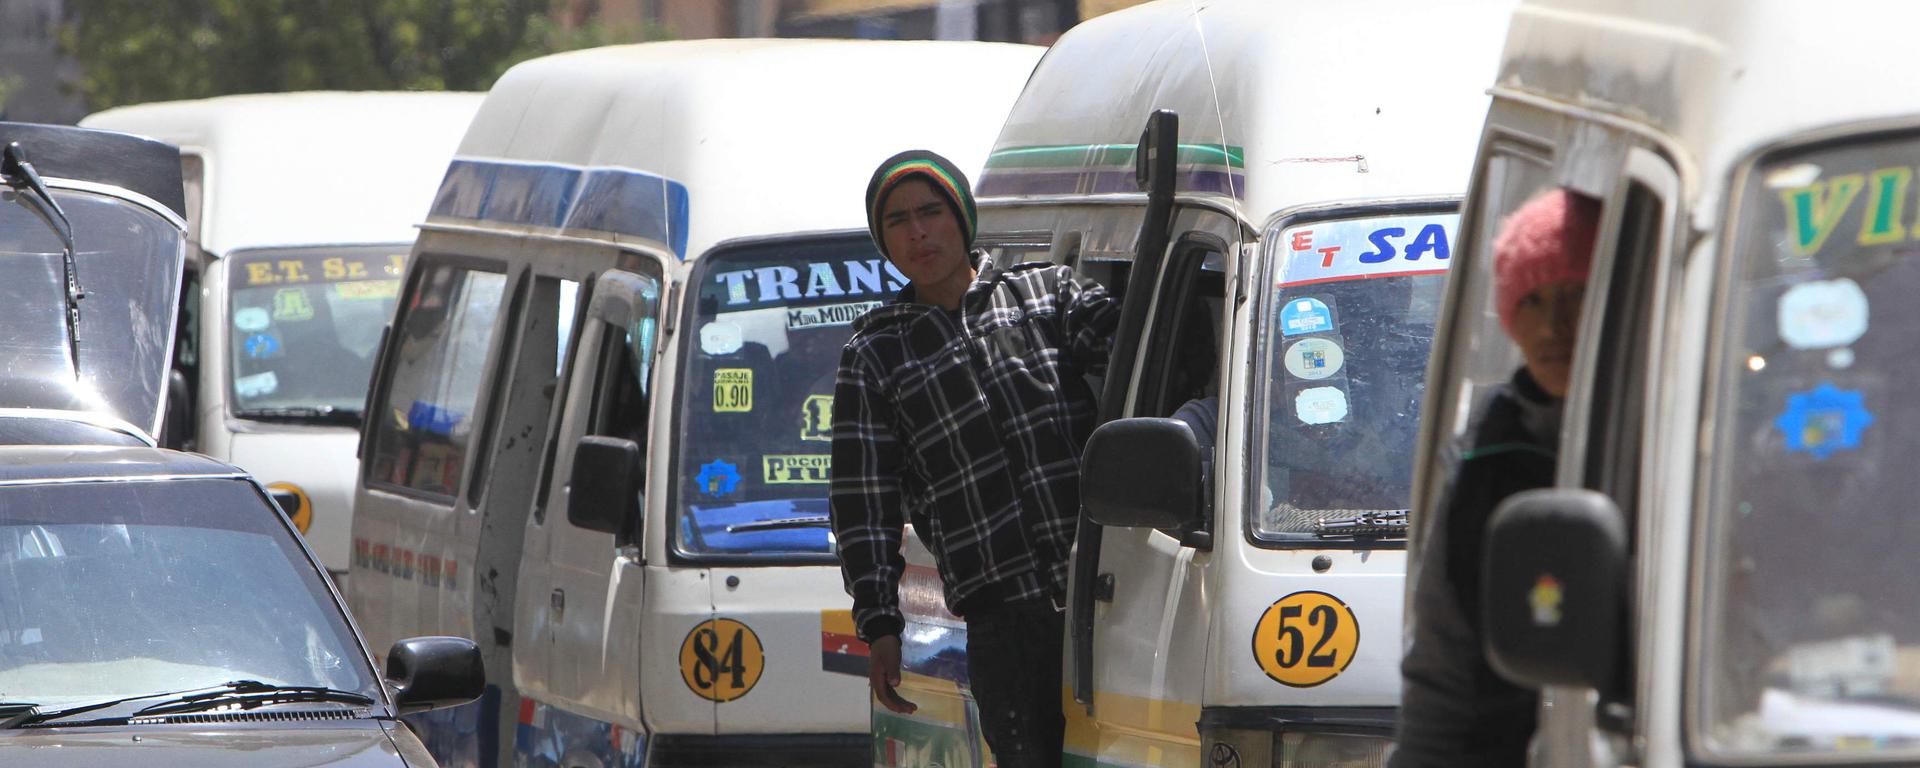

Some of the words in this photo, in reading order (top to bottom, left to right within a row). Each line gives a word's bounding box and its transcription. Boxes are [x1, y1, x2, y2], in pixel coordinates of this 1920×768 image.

[1780, 166, 1920, 257] VI
[245, 260, 309, 284] E.T.
[716, 384, 749, 407] 0.90
[694, 628, 746, 689] 84
[1275, 604, 1338, 669] 52
